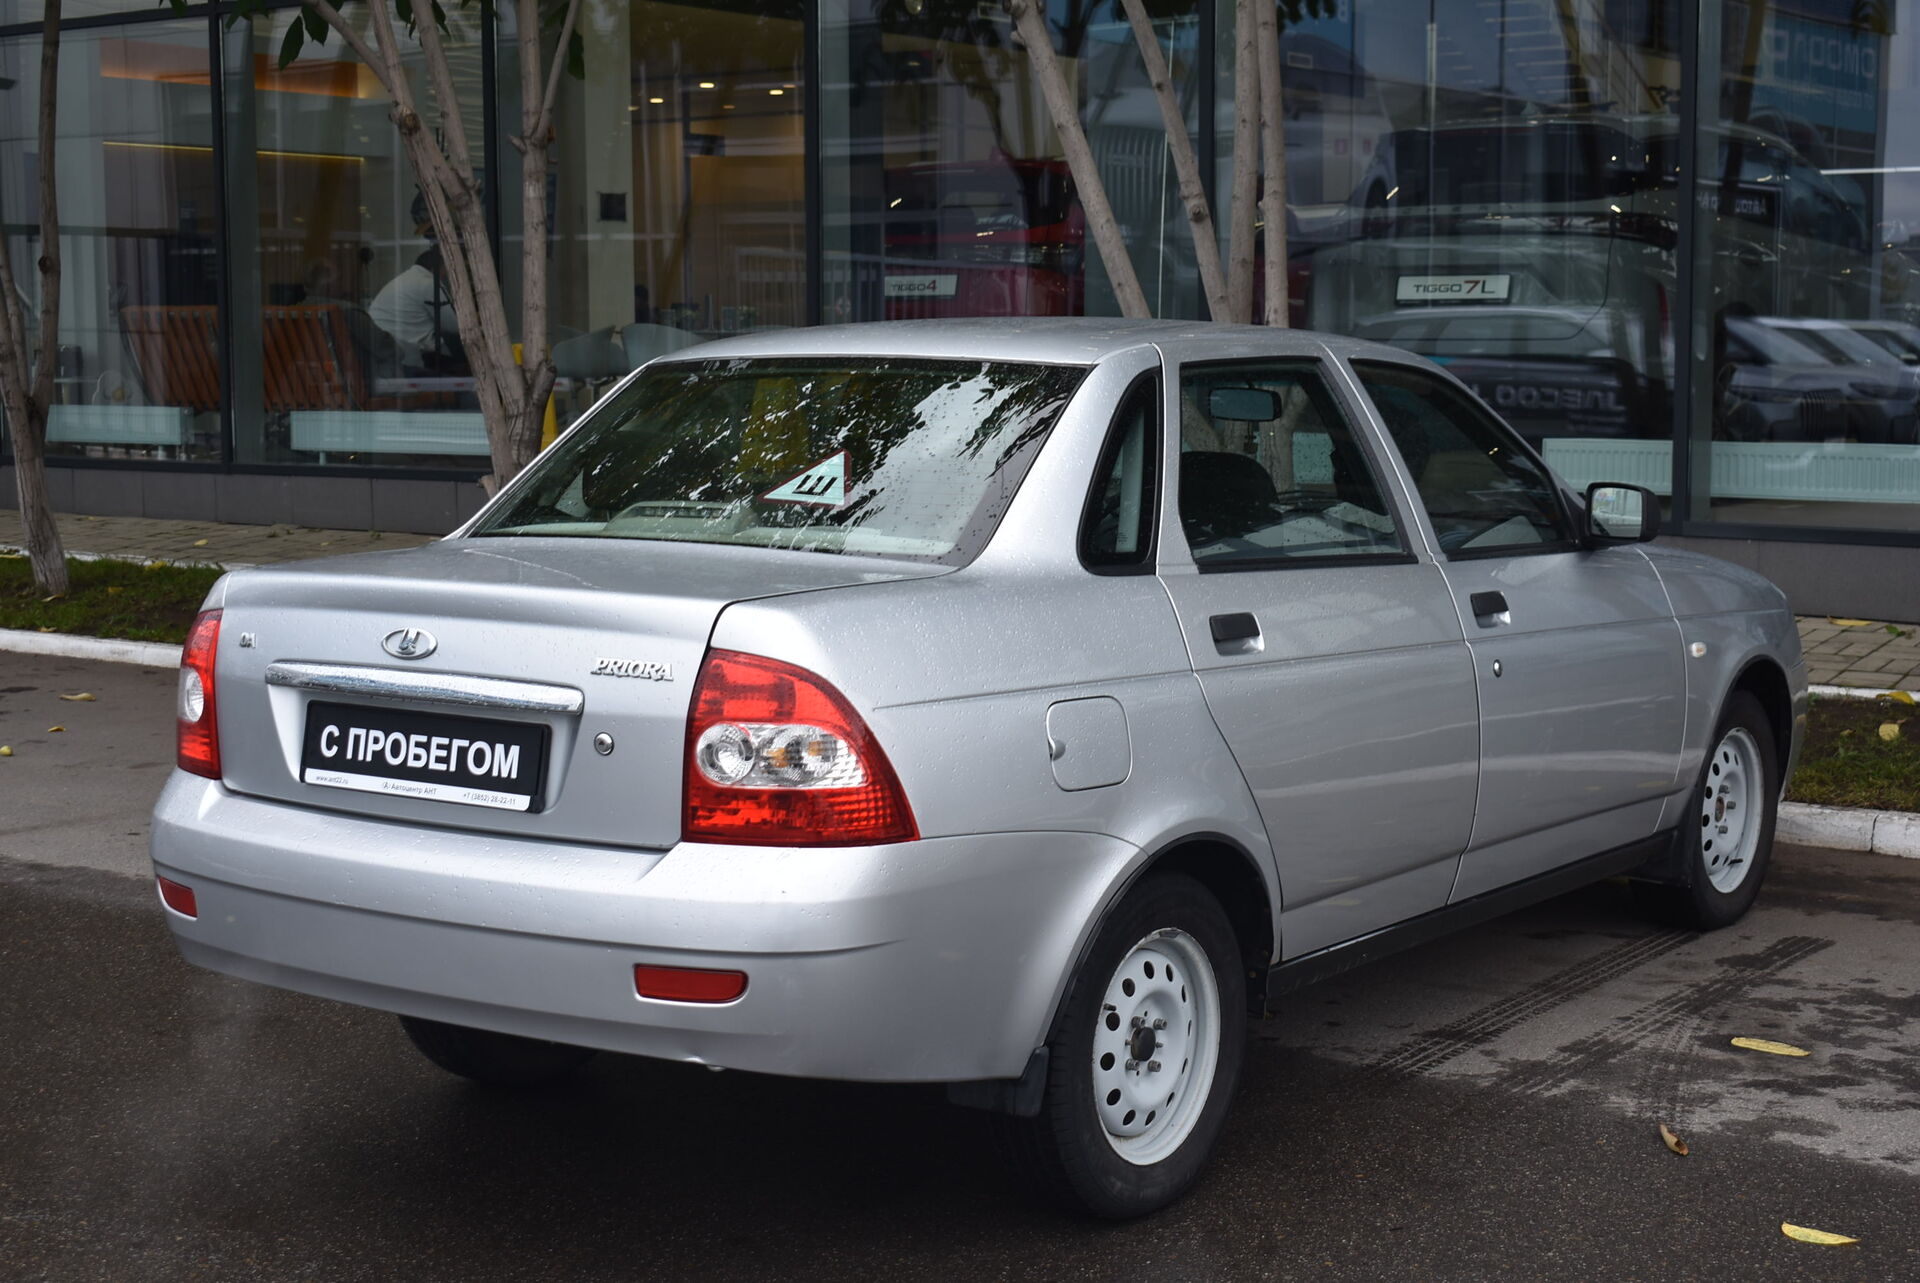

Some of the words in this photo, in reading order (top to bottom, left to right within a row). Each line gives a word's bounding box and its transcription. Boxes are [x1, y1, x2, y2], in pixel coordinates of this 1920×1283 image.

[792, 474, 838, 496] Ш
[590, 658, 674, 682] PRIORA
[320, 724, 340, 758] С
[346, 726, 521, 780] ПРОБЕГОМ
